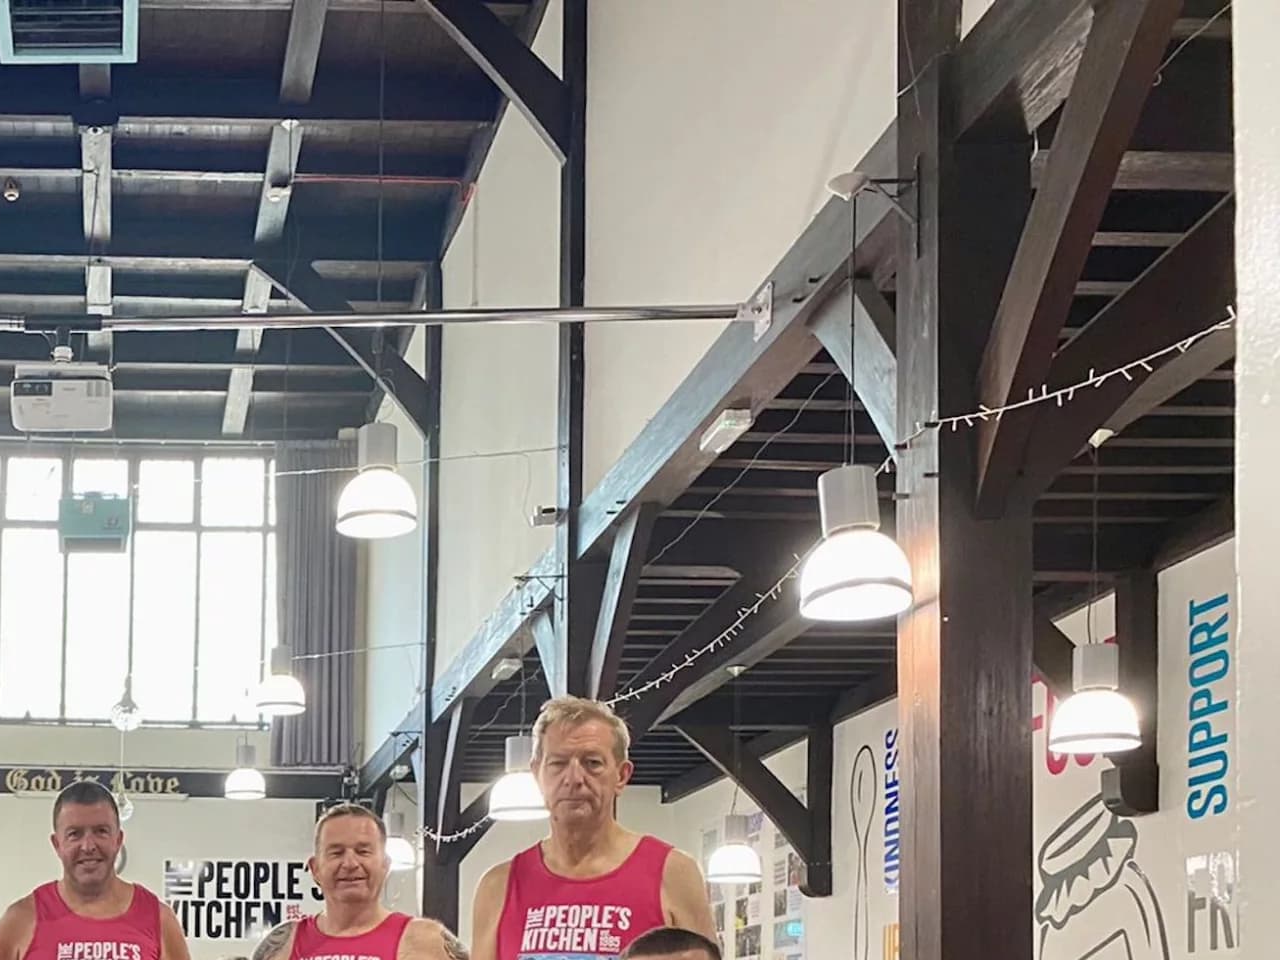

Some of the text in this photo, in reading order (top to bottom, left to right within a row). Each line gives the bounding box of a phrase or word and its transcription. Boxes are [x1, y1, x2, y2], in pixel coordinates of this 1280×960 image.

[1187, 593, 1229, 820] SUPPORT
[5, 768, 62, 792] God
[525, 905, 632, 930] THE PEOPLE'S
[521, 927, 598, 952] KITCHEN
